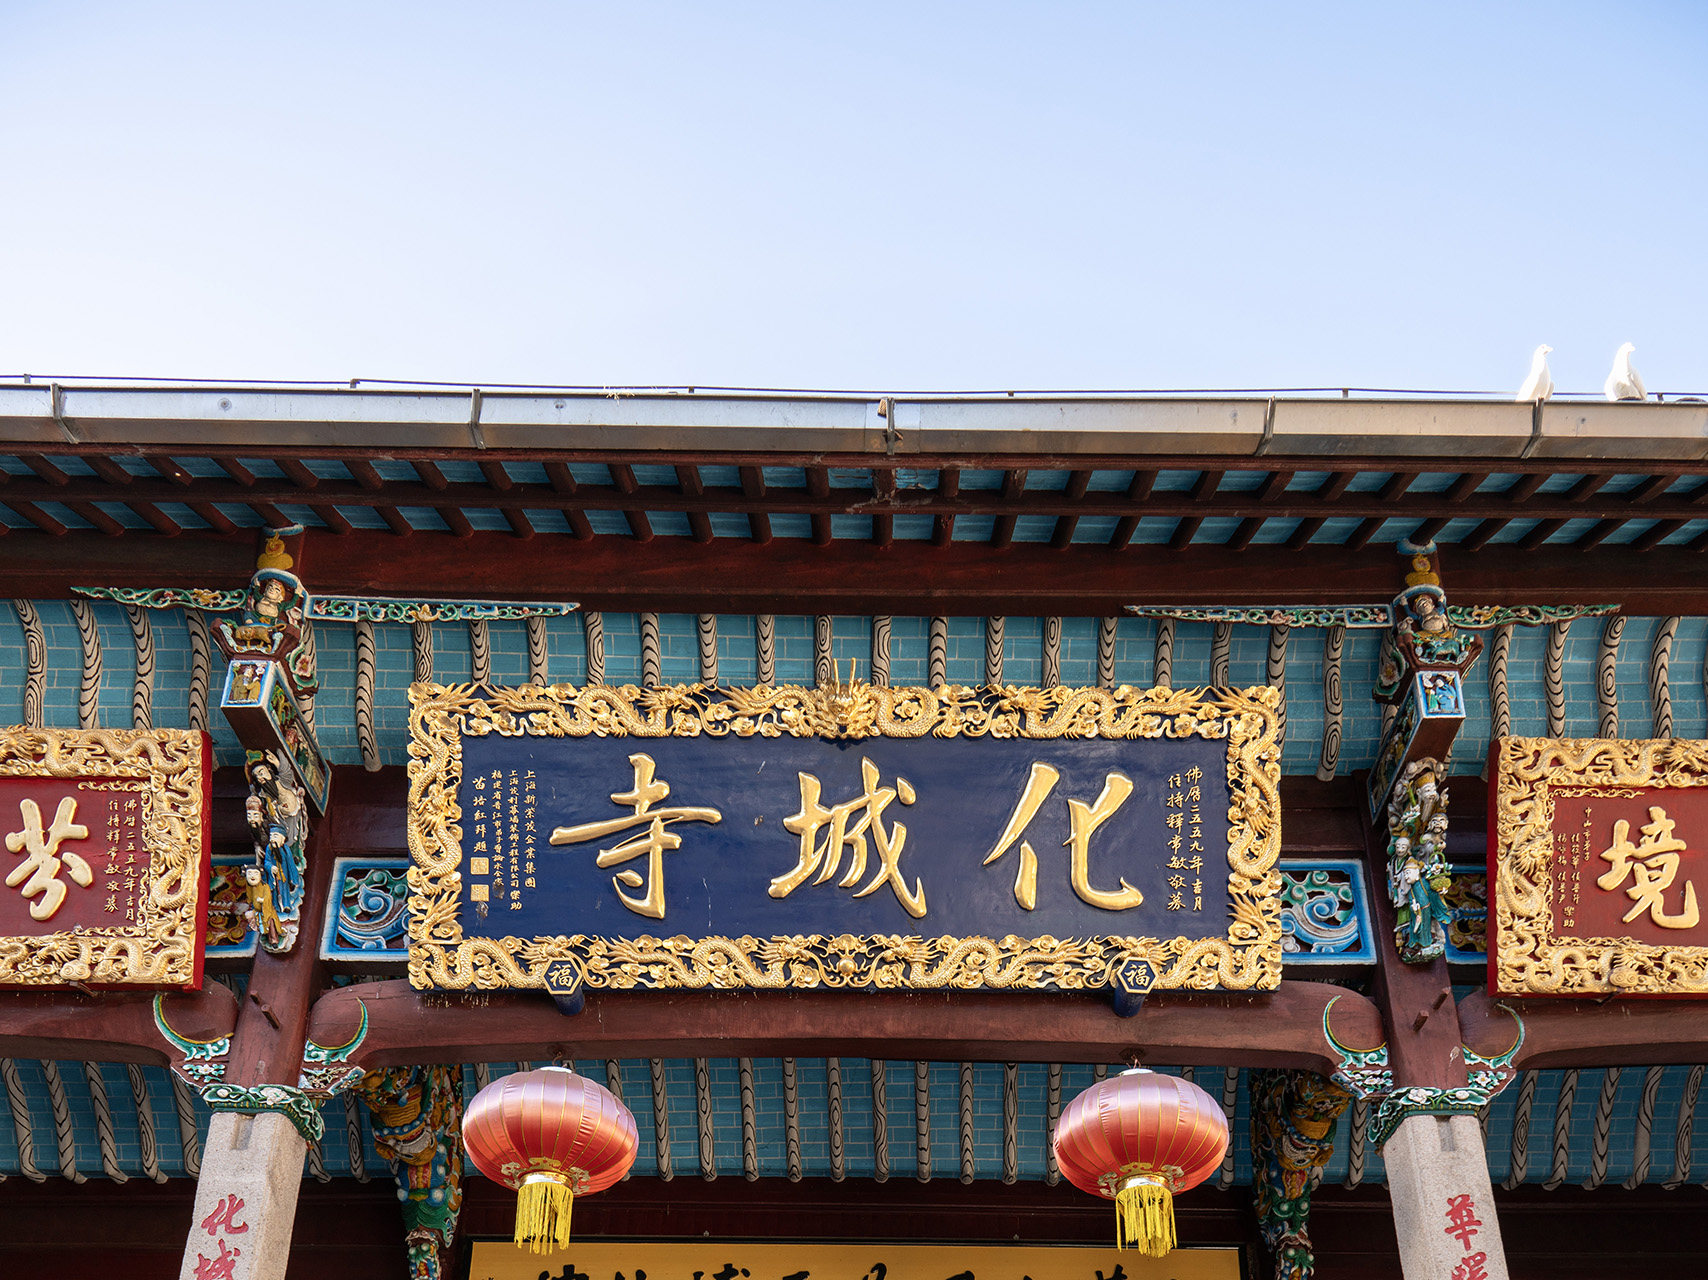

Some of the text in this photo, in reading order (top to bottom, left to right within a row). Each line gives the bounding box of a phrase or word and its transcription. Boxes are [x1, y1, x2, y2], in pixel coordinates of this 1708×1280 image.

[549, 752, 1144, 921] 化城寺
[1596, 805, 1701, 931] 境
[547, 963, 574, 988] 福
[1123, 963, 1151, 988] 福
